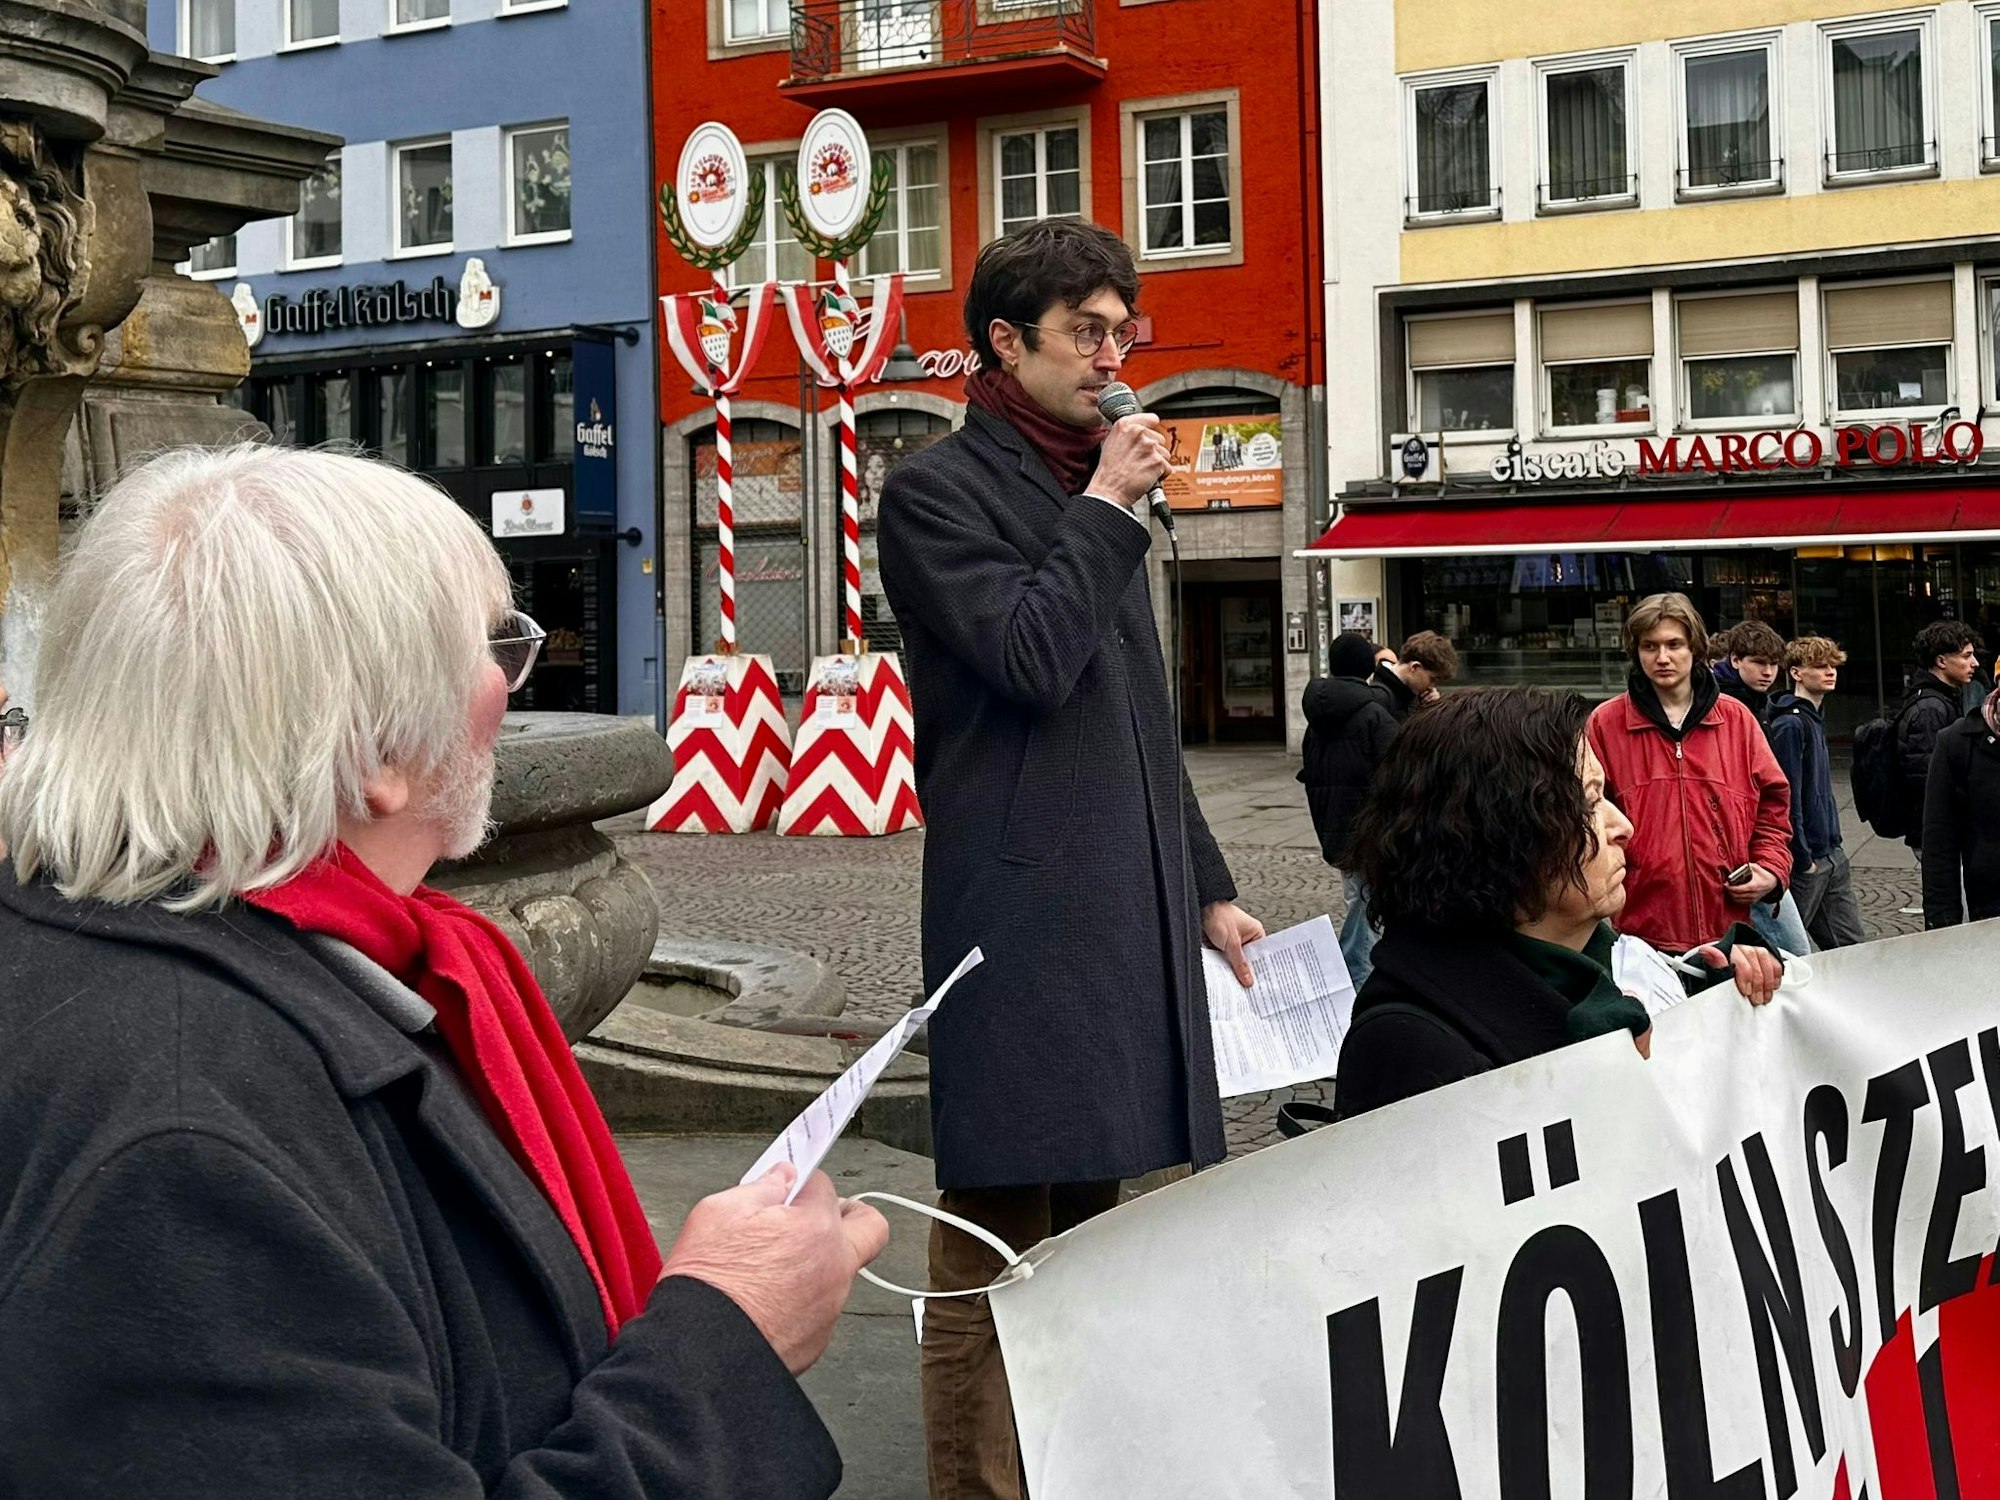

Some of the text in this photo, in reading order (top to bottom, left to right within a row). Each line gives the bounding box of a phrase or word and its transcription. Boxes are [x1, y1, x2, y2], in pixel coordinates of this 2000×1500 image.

[266, 276, 454, 333] Gaffel Kölsch
[576, 421, 614, 446] Gaffel
[1490, 421, 1984, 482] eiscafe MARCO POLO
